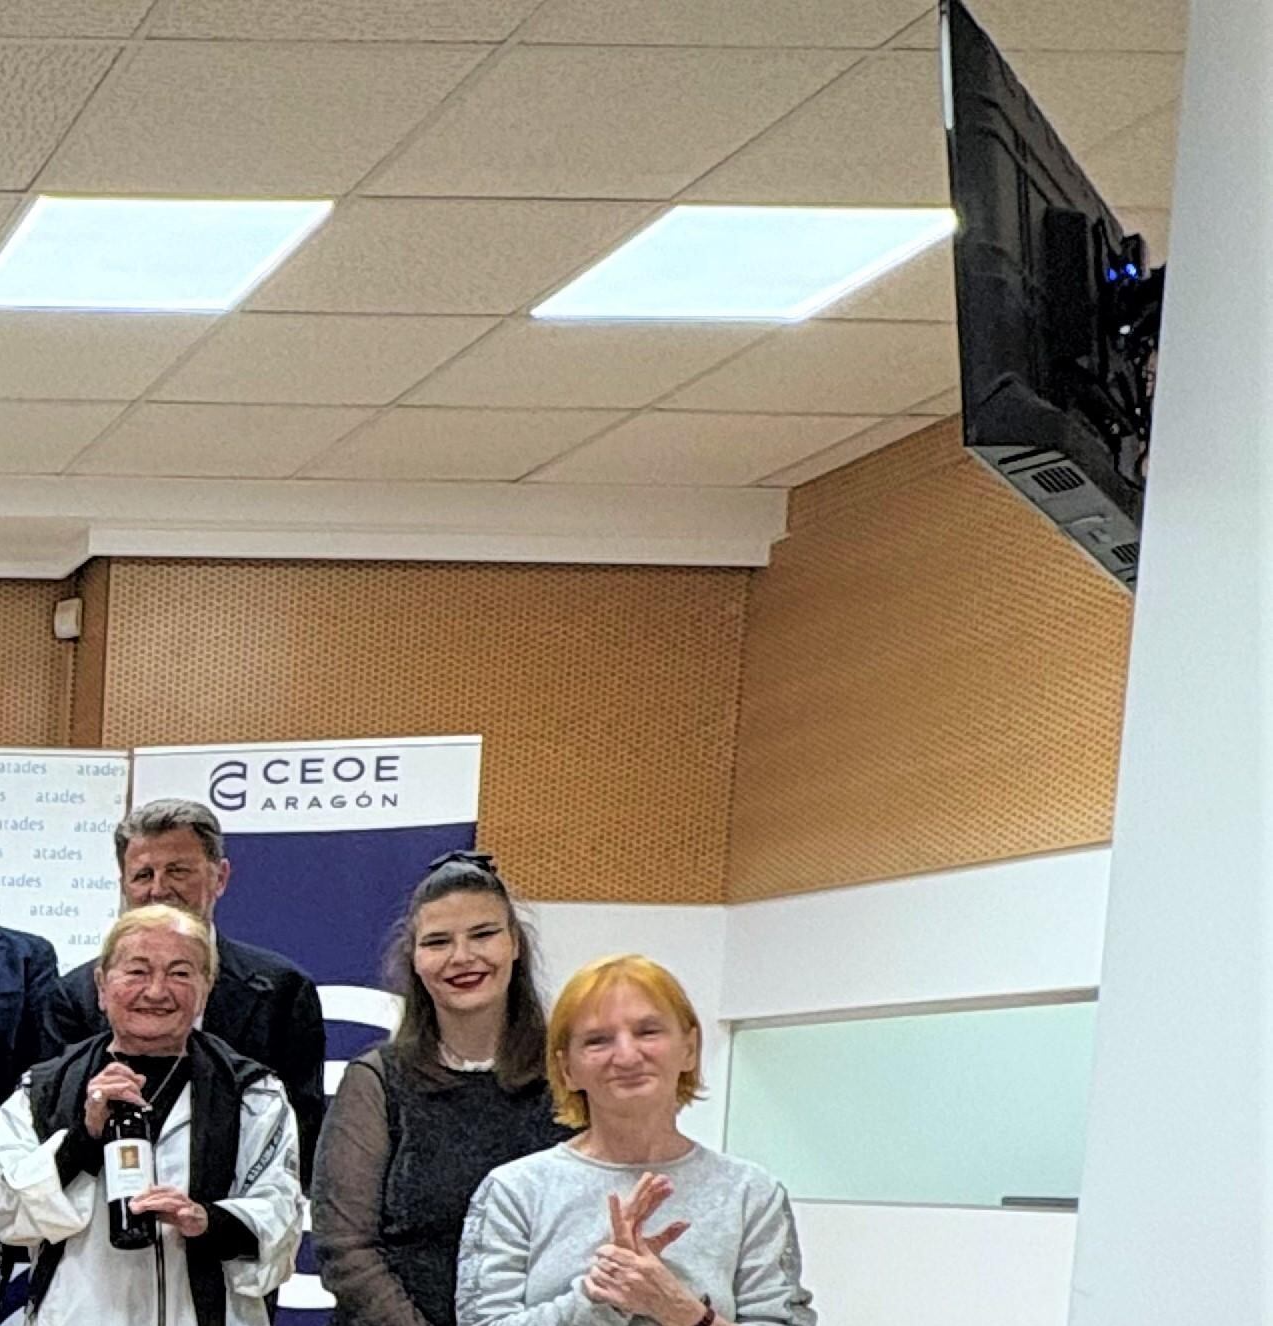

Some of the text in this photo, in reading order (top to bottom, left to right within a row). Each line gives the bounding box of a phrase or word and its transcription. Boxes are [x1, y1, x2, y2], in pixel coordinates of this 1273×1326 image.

[77, 763, 126, 777] atades
[262, 756, 400, 785] CEOE
[36, 790, 86, 804] atades
[260, 790, 399, 811] ARAGÓN
[33, 846, 83, 860] atades
[29, 901, 79, 917] atades
[68, 932, 102, 946] atad
